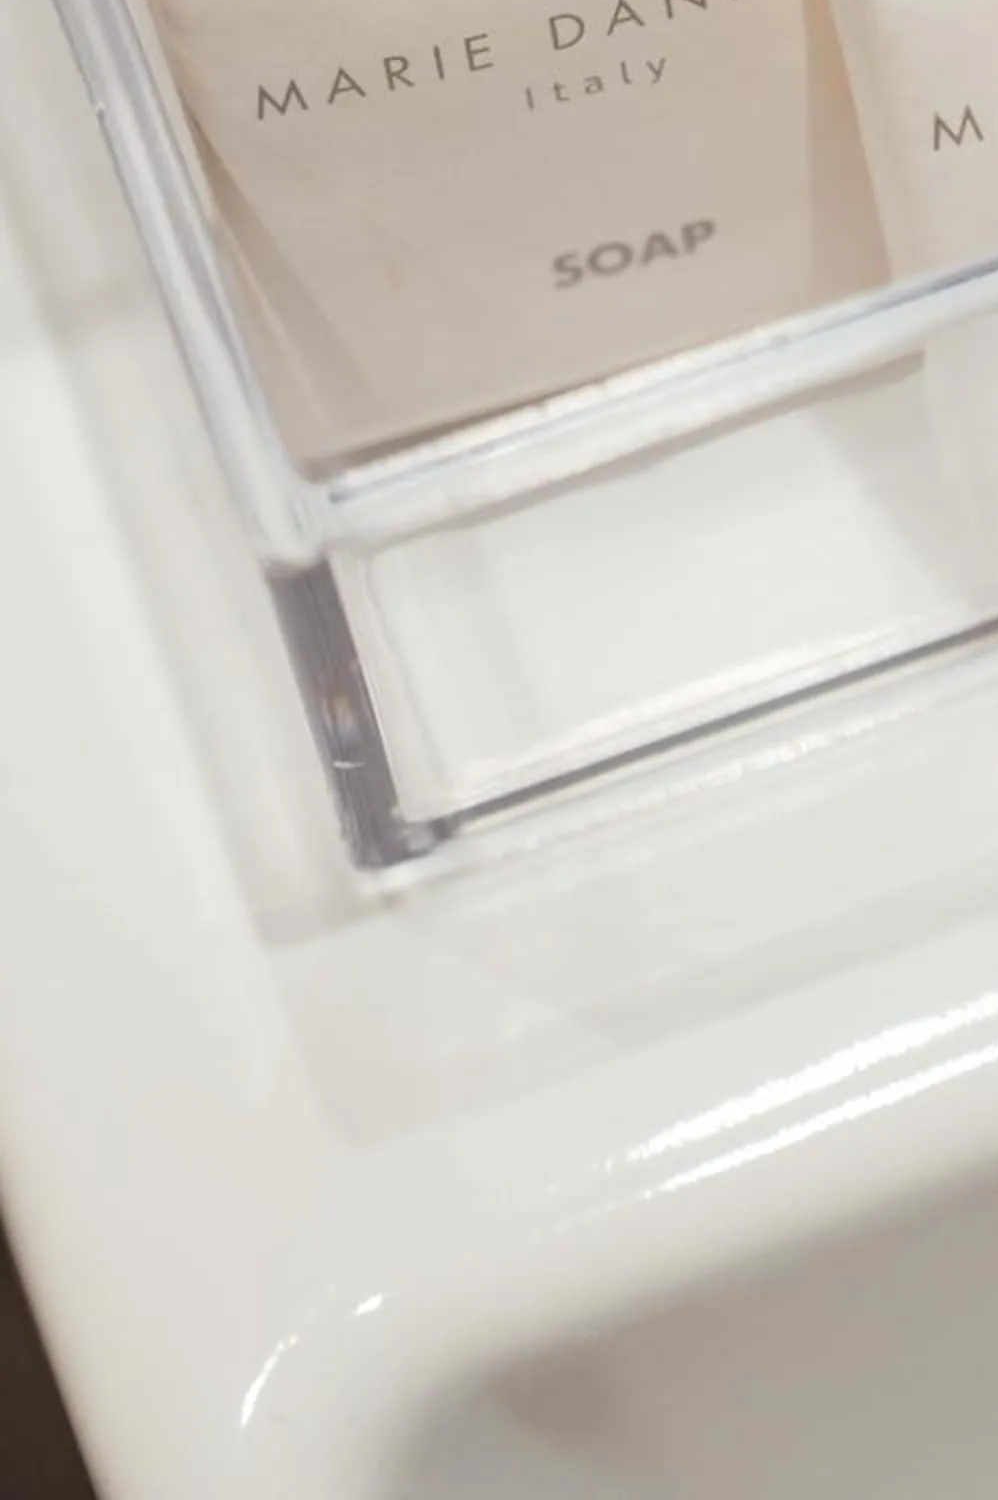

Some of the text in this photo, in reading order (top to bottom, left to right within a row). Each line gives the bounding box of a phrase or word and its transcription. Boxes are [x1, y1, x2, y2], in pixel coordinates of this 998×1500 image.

[256, 32, 495, 121] MARIE
[524, 56, 668, 111] Italy
[552, 218, 717, 291] SOAP
